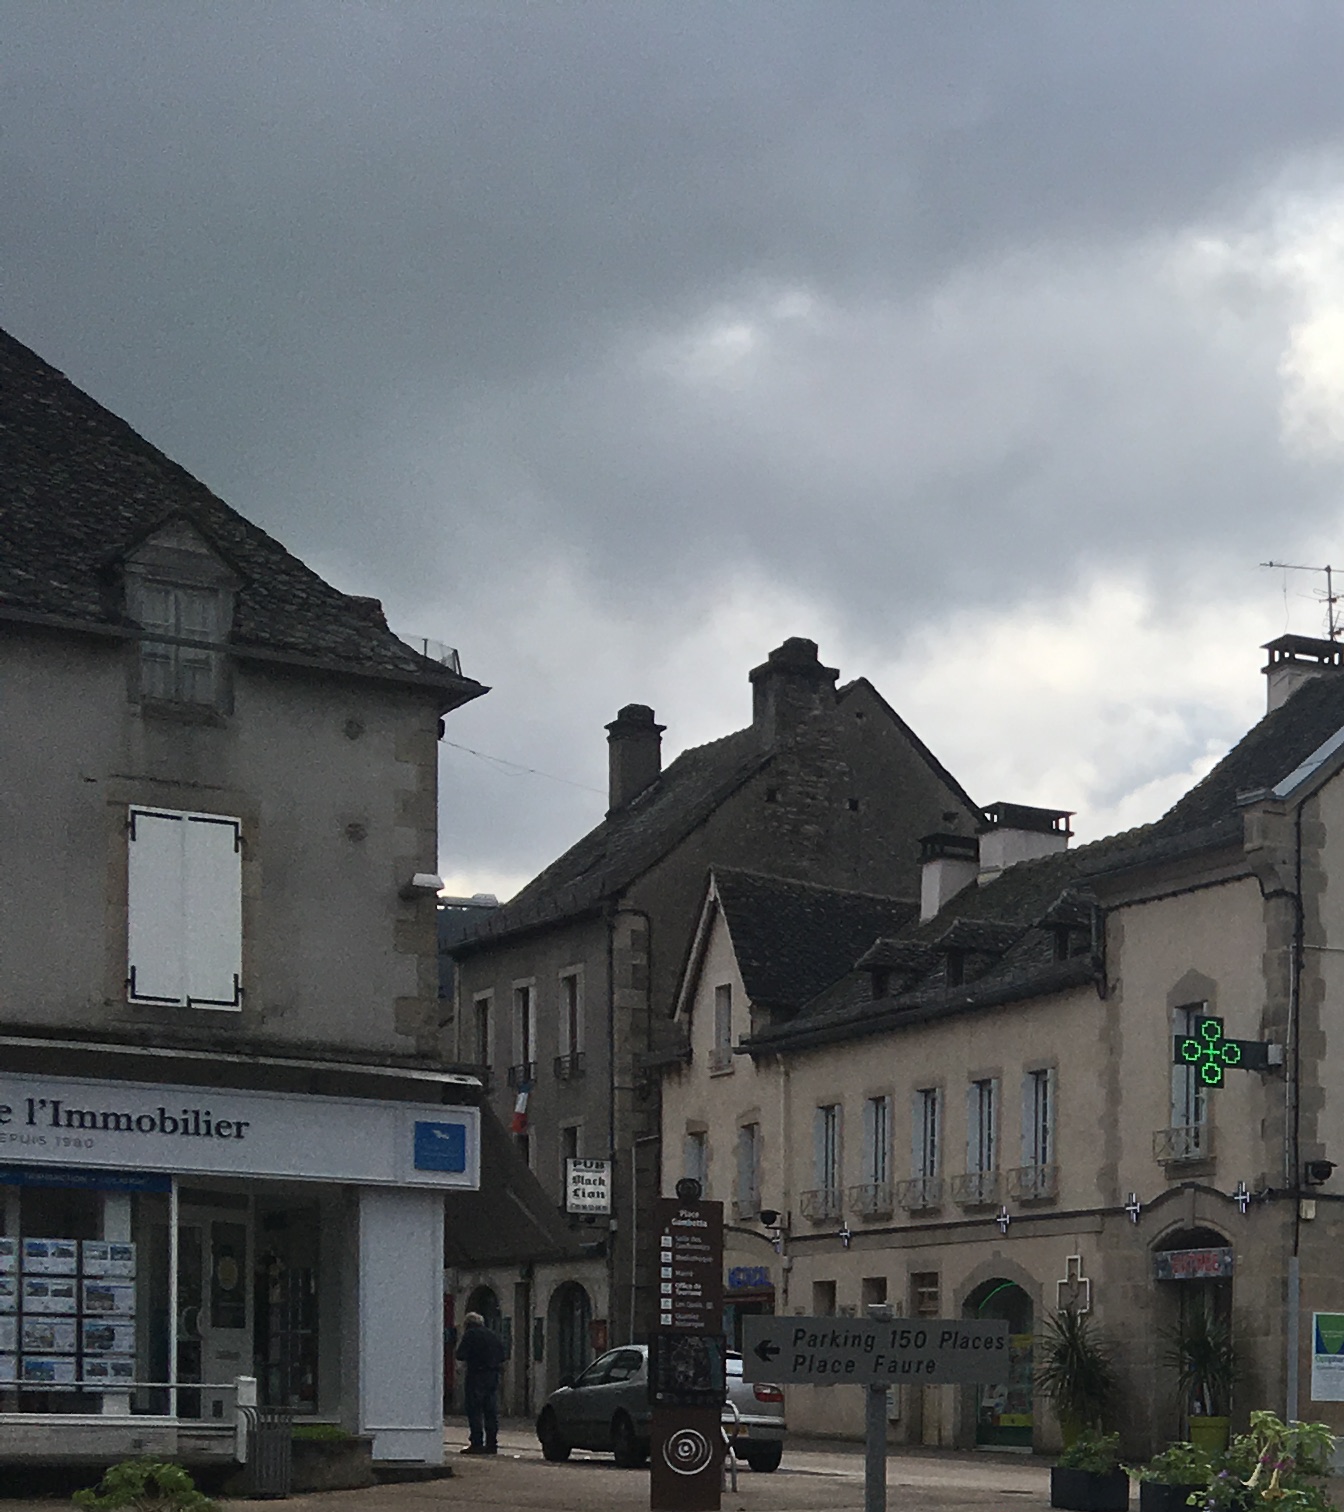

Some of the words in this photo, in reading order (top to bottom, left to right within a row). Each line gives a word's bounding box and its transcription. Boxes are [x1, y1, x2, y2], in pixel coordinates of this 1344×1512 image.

[0, 1105, 12, 1125] e
[25, 1097, 250, 1140] l'Immobilier
[0, 1133, 47, 1146] EPUIS
[573, 1160, 605, 1169] PUB
[792, 1328, 876, 1353] Parking
[890, 1330, 927, 1349] 150
[939, 1331, 1004, 1350] Places
[792, 1355, 855, 1374] Place
[873, 1356, 936, 1375] Faure
